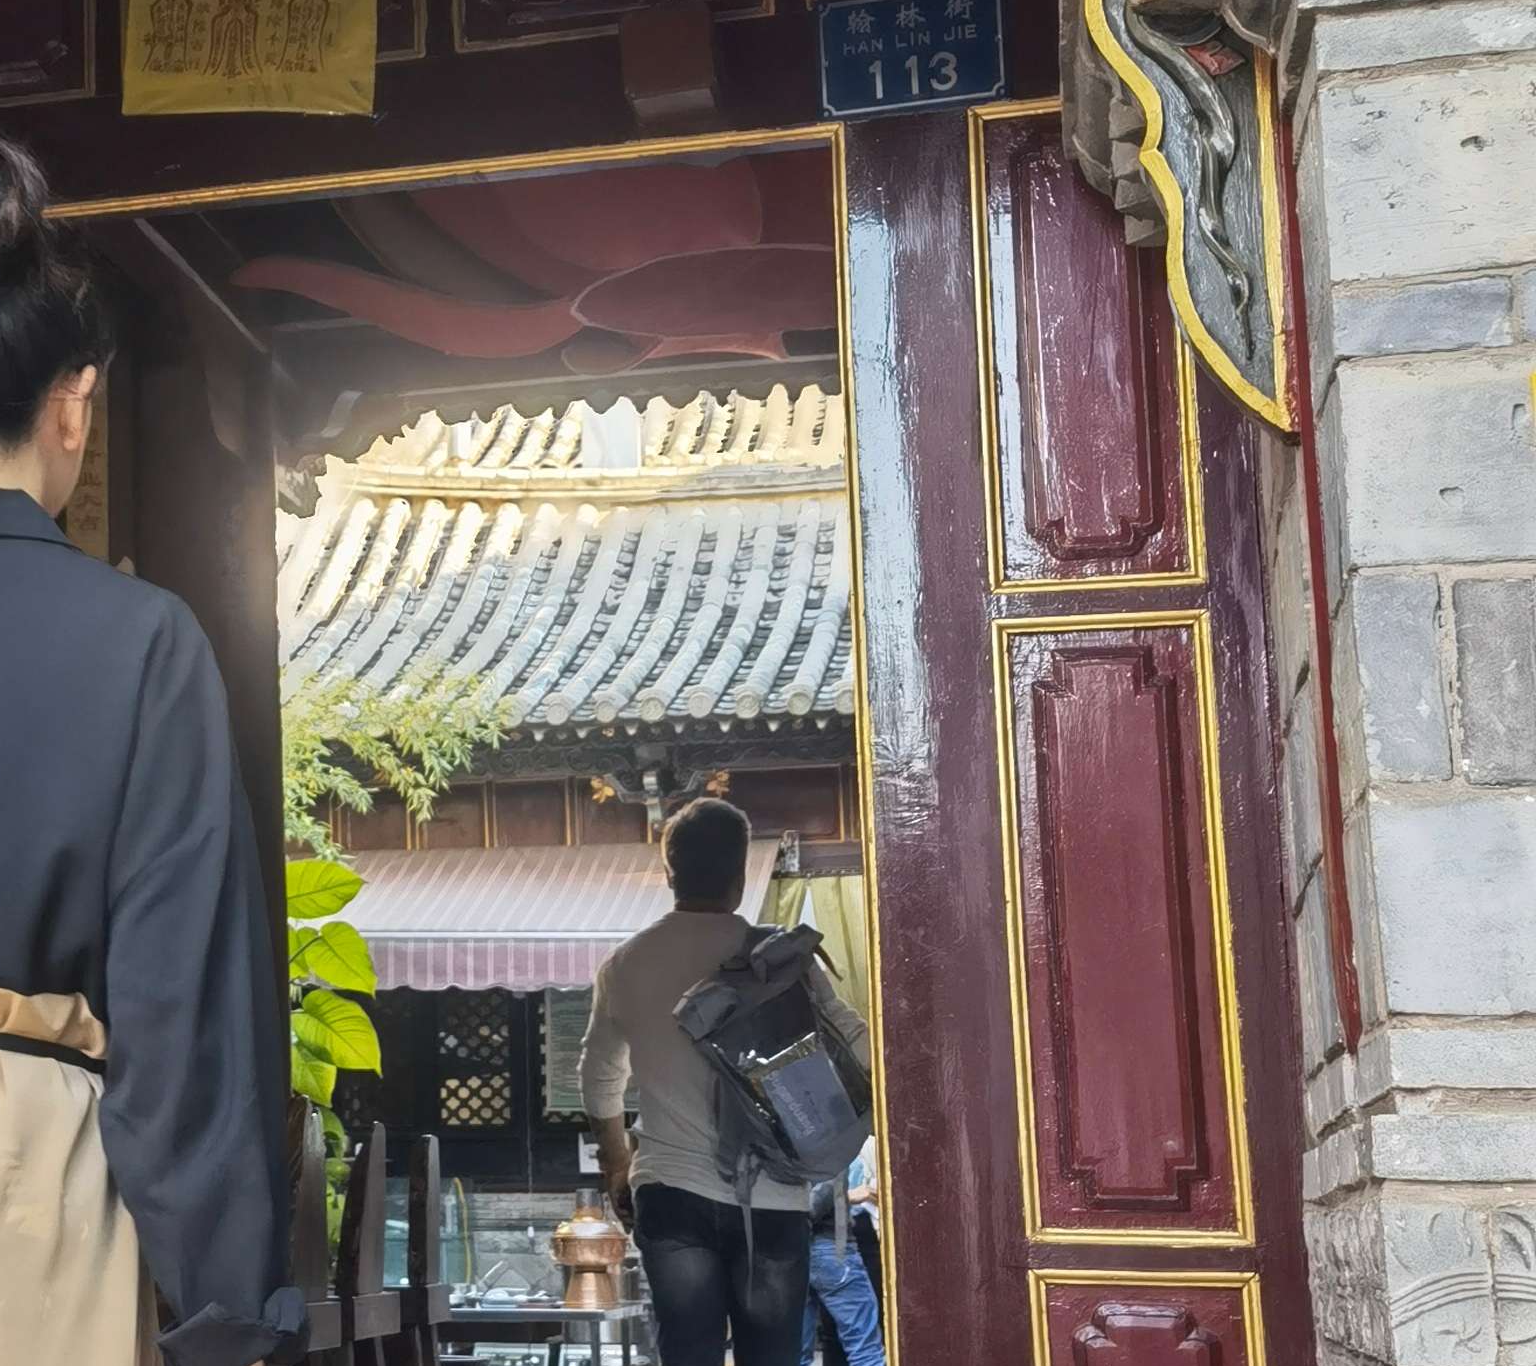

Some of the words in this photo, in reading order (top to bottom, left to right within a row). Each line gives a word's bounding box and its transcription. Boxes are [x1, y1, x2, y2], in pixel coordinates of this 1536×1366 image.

[842, 38, 884, 56] HAN
[895, 30, 931, 47] LIN
[943, 23, 978, 41] JIE
[868, 51, 958, 100] 113
